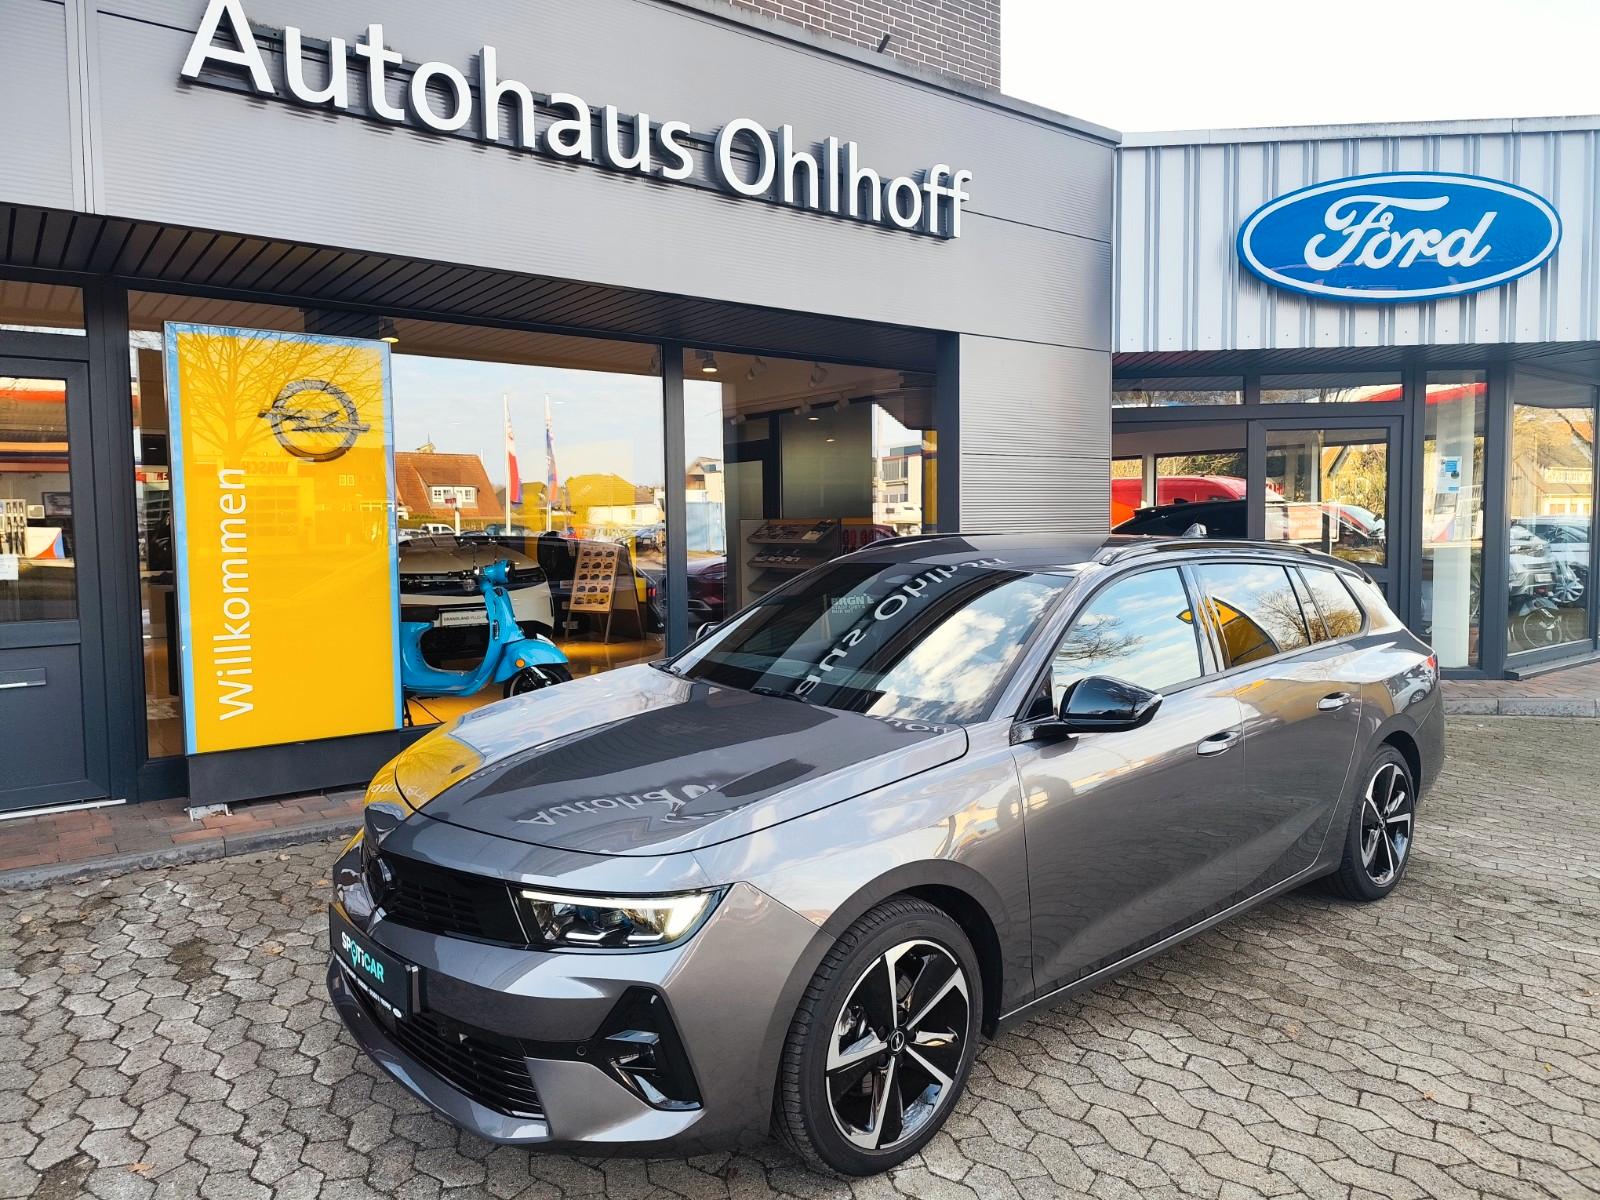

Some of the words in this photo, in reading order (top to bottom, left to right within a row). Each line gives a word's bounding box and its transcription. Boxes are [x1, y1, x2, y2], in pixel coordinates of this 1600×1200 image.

[181, 0, 694, 180] Autohaus
[715, 118, 972, 239] Ohlhoff
[1303, 194, 1497, 271] Ford
[214, 468, 254, 721] Willkommen
